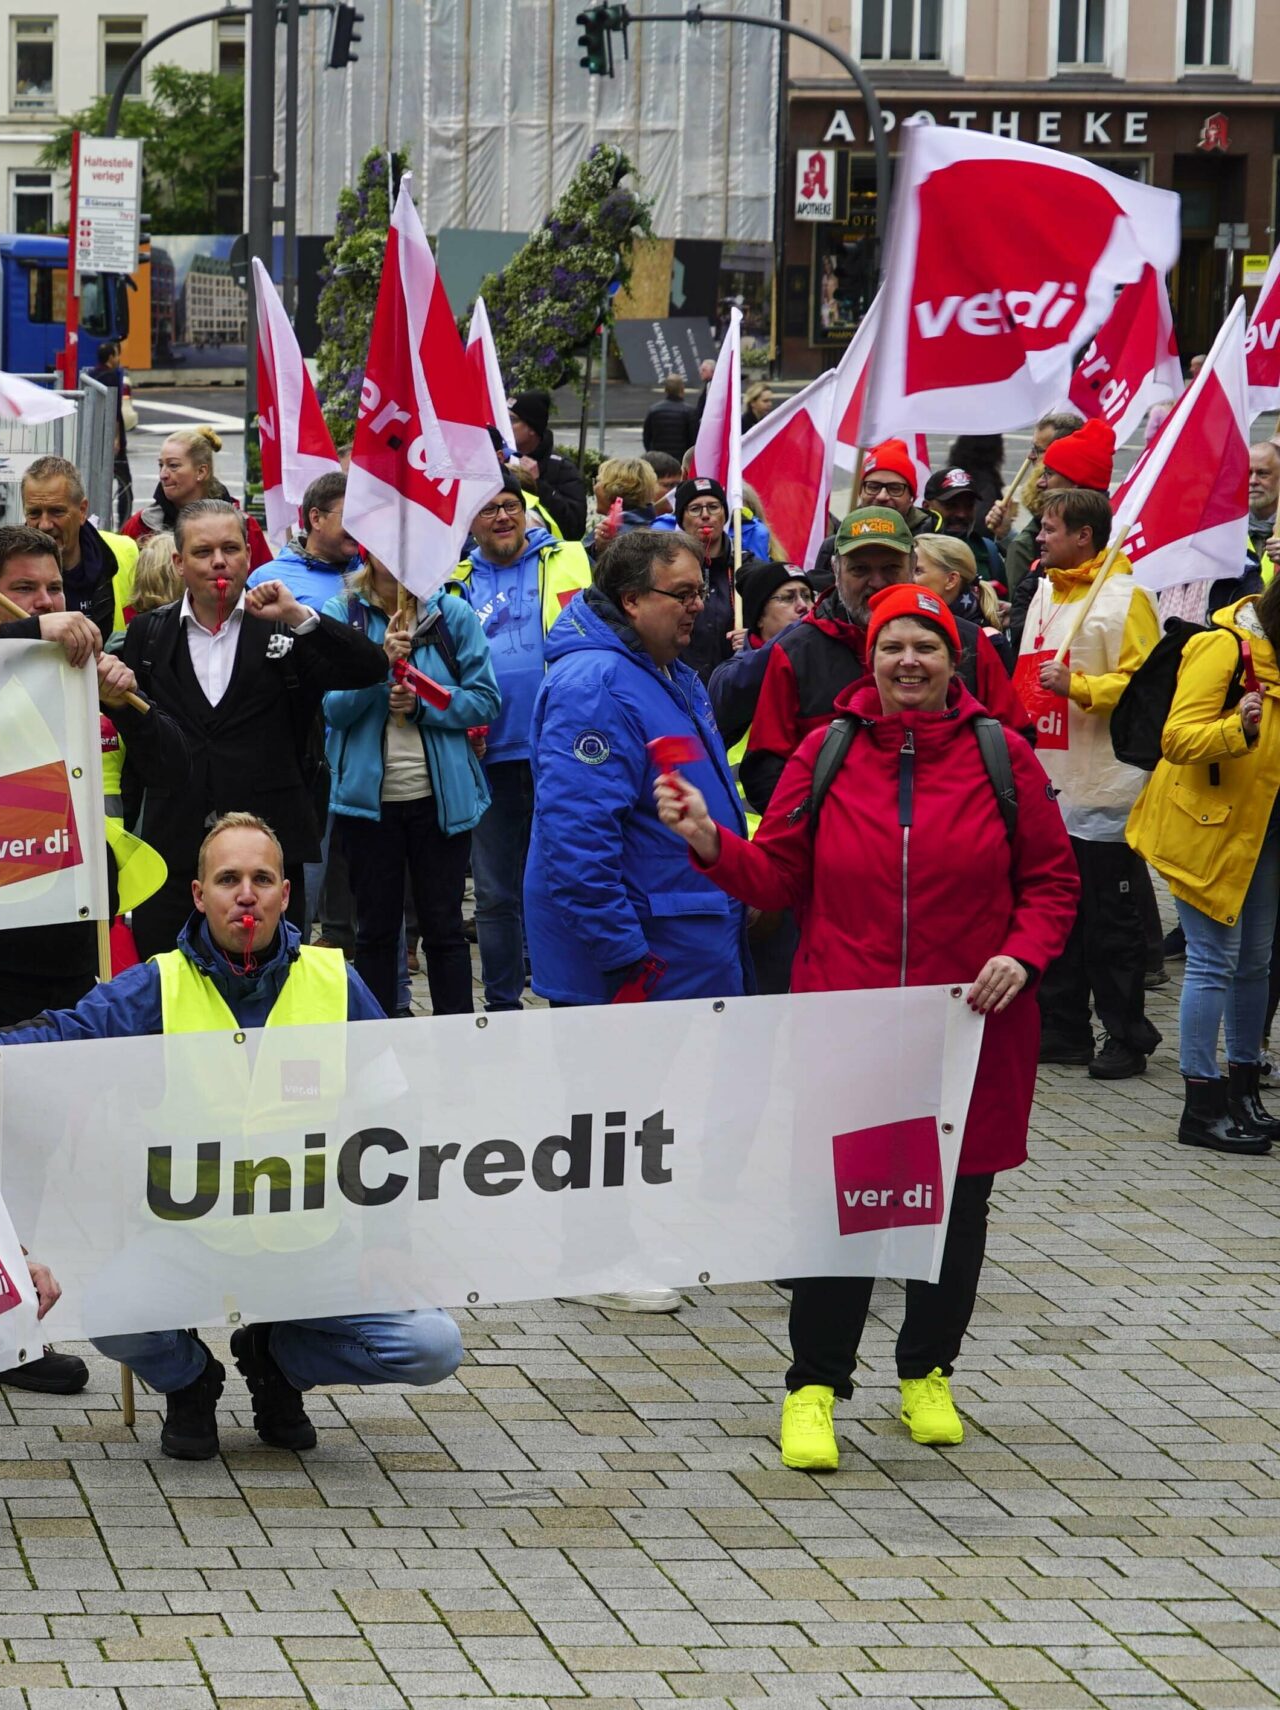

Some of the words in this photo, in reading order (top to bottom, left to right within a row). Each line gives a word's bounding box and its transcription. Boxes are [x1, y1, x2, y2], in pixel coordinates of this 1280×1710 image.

[84, 156, 133, 169] Haltestelle
[92, 171, 124, 183] verlegt
[797, 203, 832, 216] APOTHEKE
[146, 1109, 675, 1221] UniCredit
[843, 1183, 933, 1209] ver.di
